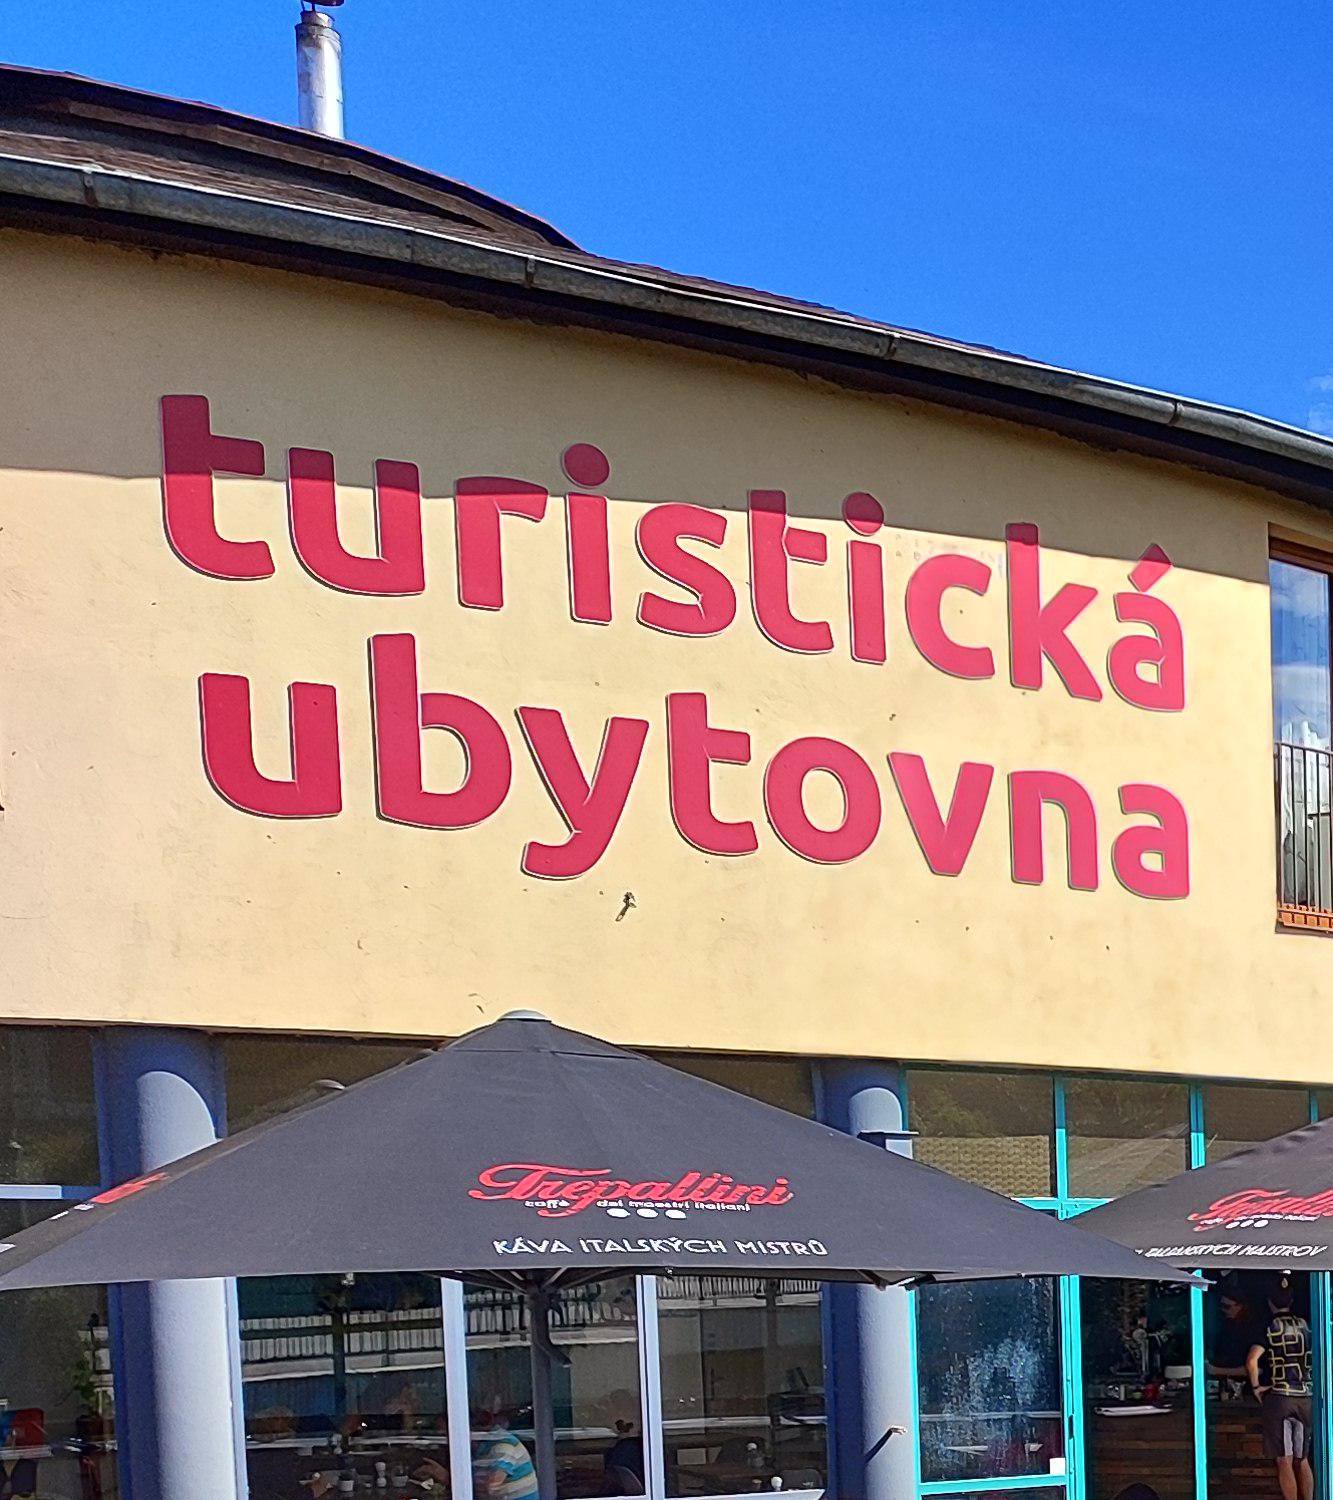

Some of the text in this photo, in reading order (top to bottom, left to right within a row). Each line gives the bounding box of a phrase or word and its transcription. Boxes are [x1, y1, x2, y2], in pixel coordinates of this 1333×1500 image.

[160, 393, 1187, 713] turistická
[198, 632, 1190, 899] ubytovna
[468, 1162, 795, 1218] Trepallini
[493, 1236, 574, 1254] KÁVA
[579, 1236, 728, 1254] ITALSKÝCH
